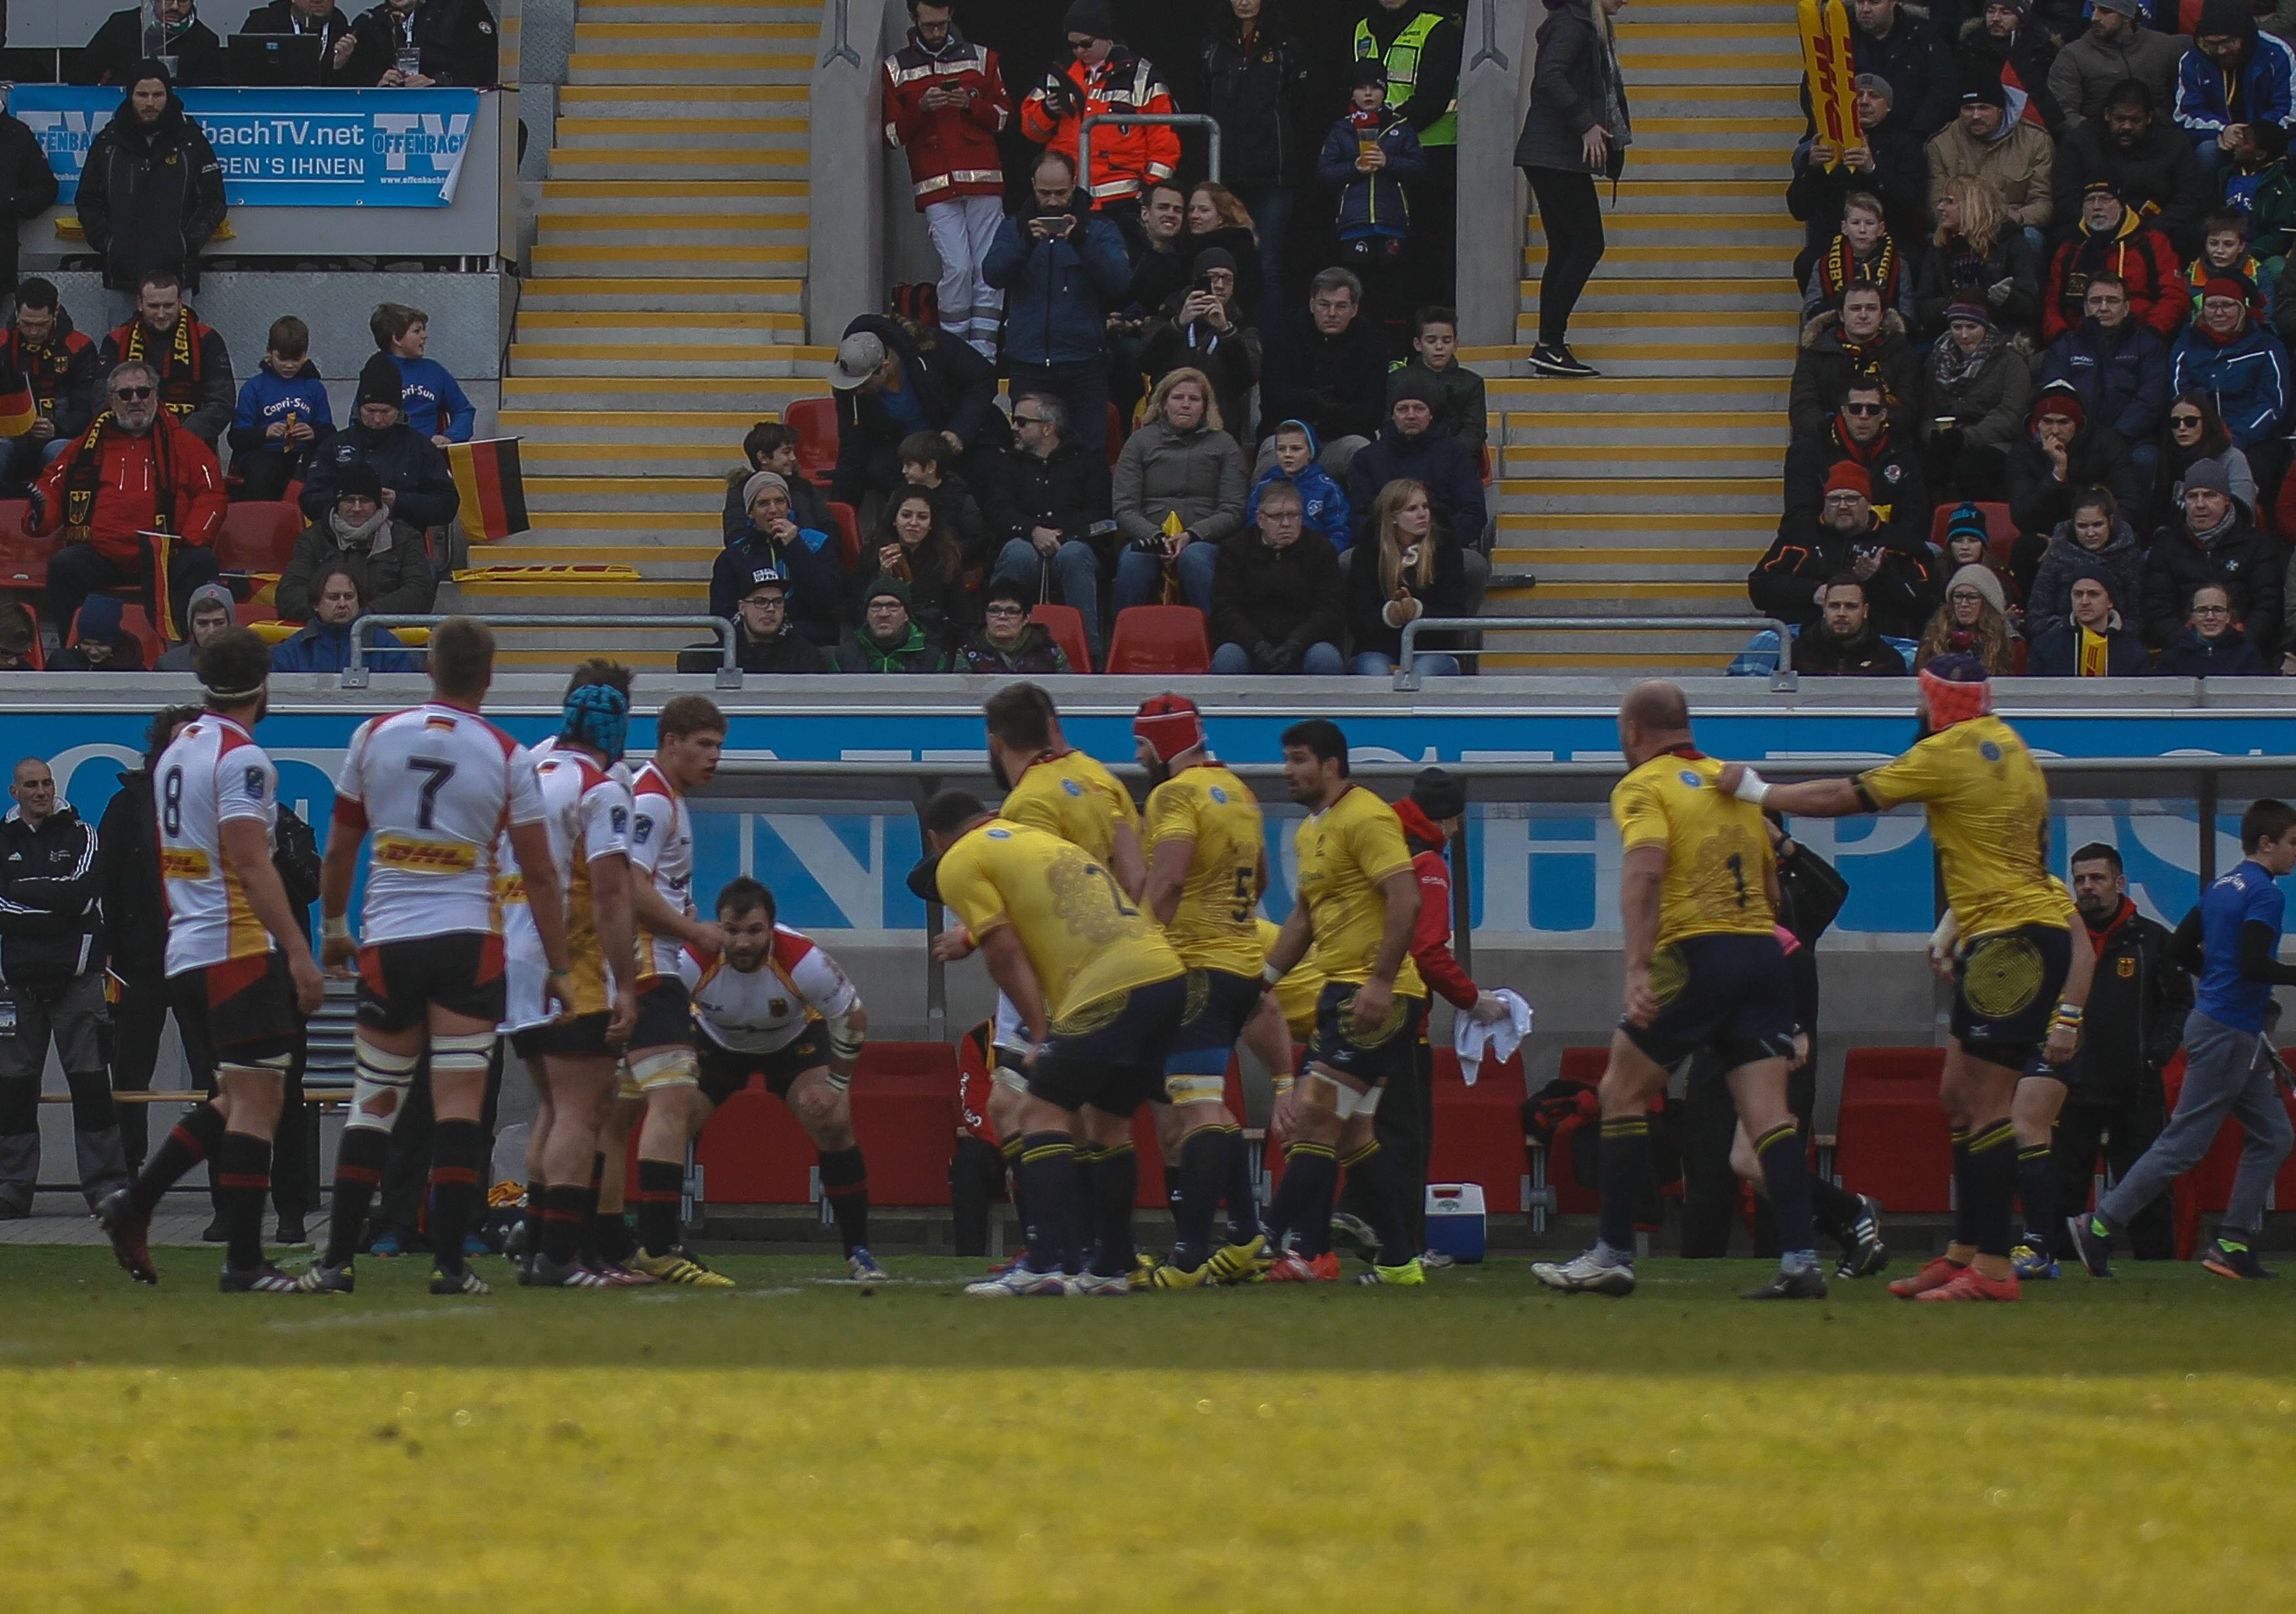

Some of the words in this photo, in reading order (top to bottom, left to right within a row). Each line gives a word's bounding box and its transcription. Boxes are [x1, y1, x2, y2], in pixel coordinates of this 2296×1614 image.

[202, 121, 365, 146] bachTV.net
[373, 113, 470, 171] TV
[216, 158, 259, 174] GEN
[293, 158, 363, 175] IHNEN
[1828, 235, 1844, 291] RUGBY
[263, 397, 311, 416] Capri-Sun
[165, 765, 181, 838] 8
[408, 756, 457, 830] 7
[384, 843, 471, 866] DHL
[1727, 853, 1748, 908] 1
[1086, 862, 1140, 916] 2
[1231, 867, 1253, 921] 5
